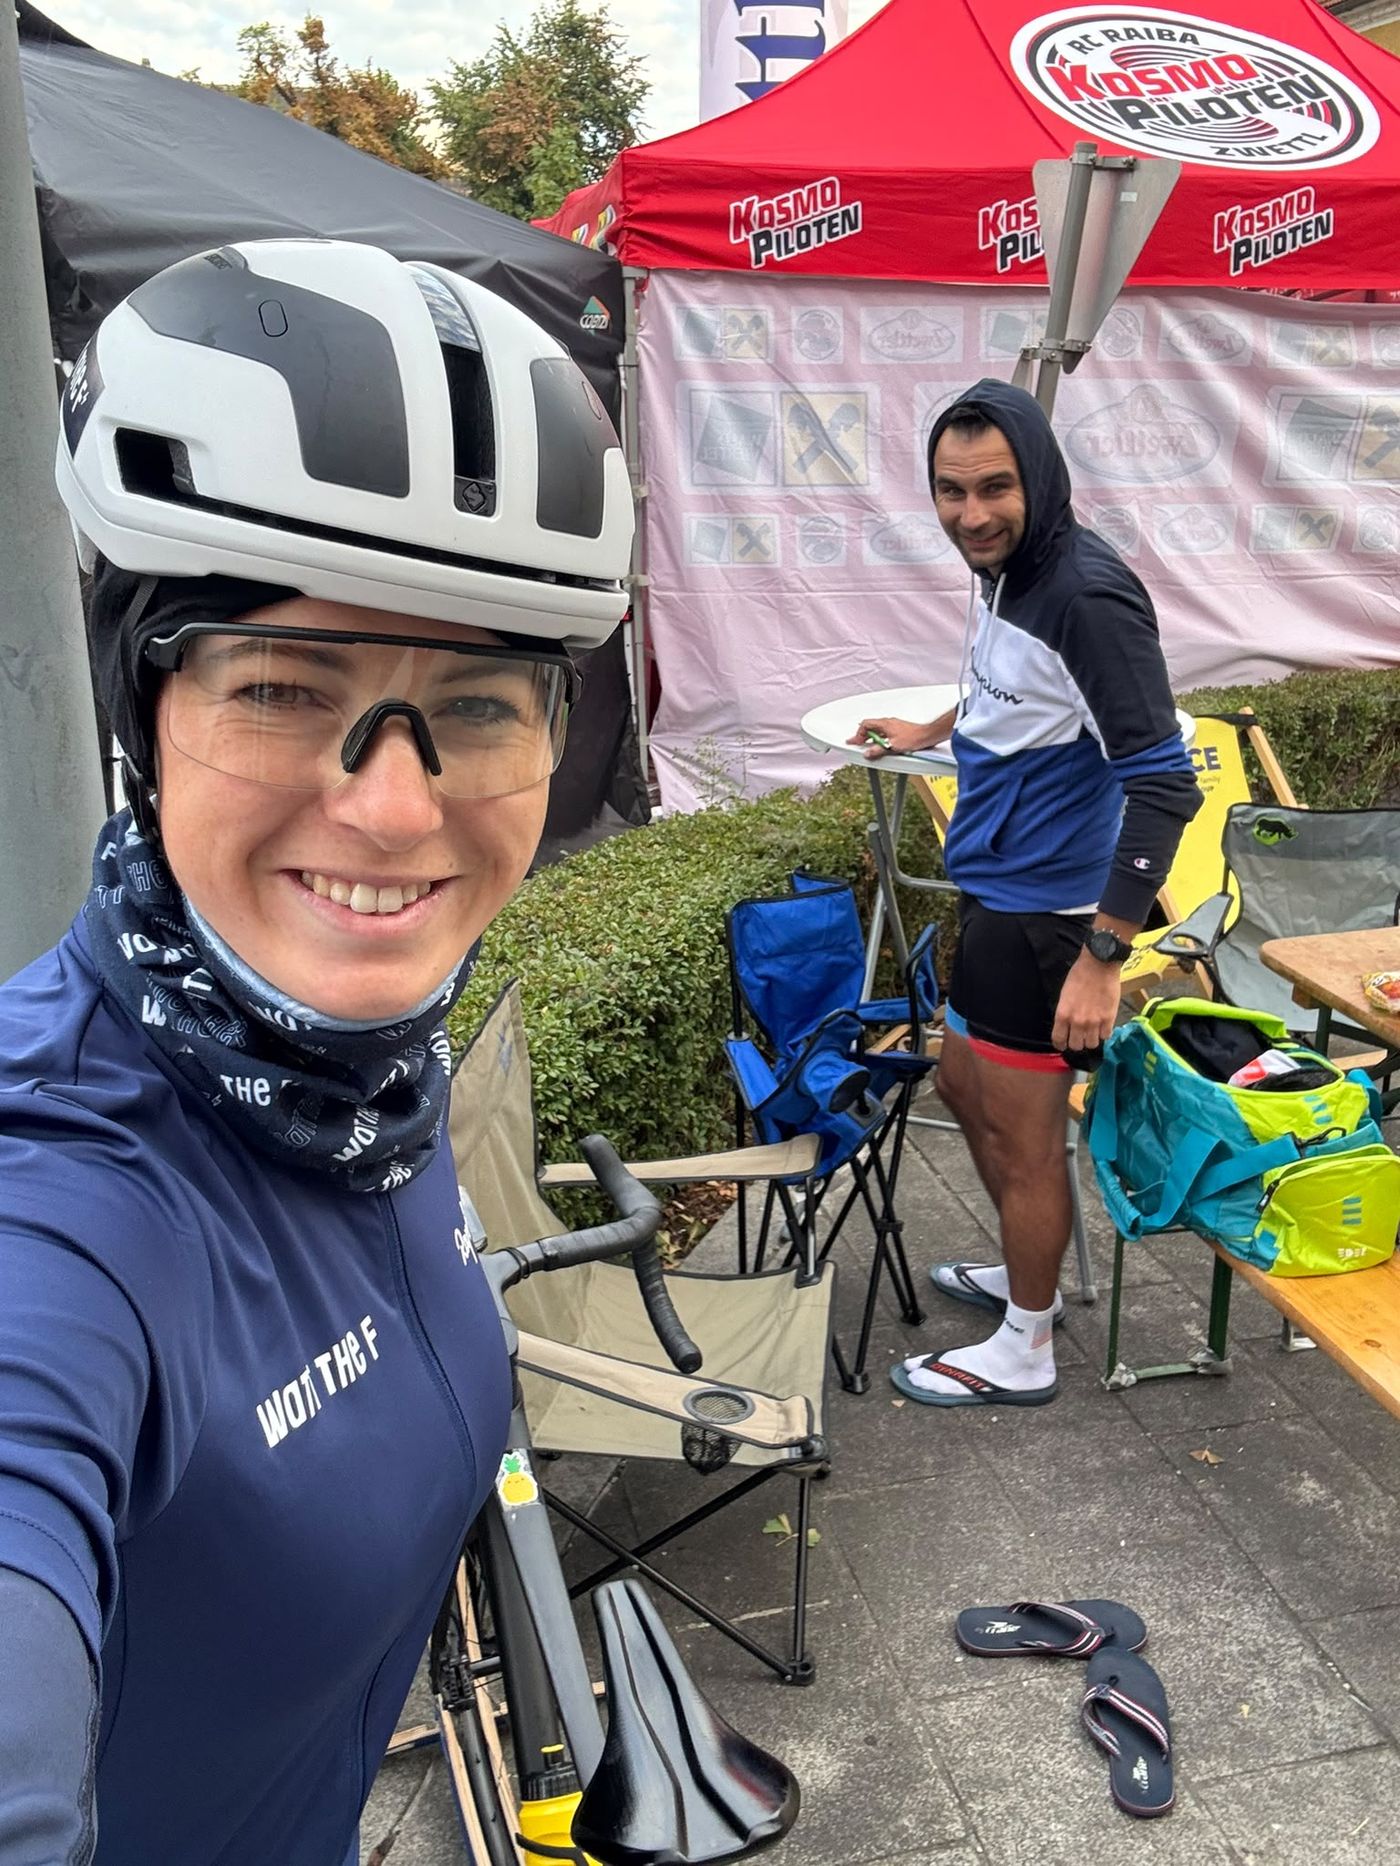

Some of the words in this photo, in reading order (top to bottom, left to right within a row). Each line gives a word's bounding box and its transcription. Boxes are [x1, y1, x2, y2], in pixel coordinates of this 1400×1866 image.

[1066, 33, 1104, 56] RC
[1100, 27, 1200, 46] RAIBA
[1045, 53, 1260, 102] KOSMO
[1106, 73, 1329, 131] PILOTEN
[1209, 132, 1328, 157] ZWETTL
[730, 177, 839, 243] KOSMO
[750, 202, 862, 269] PILOTEN
[979, 197, 1040, 250] KOS
[1214, 186, 1315, 254] KOSMO
[997, 230, 1045, 273] PIL
[1230, 208, 1334, 277] PILOTEN
[360, 1314, 379, 1361] F
